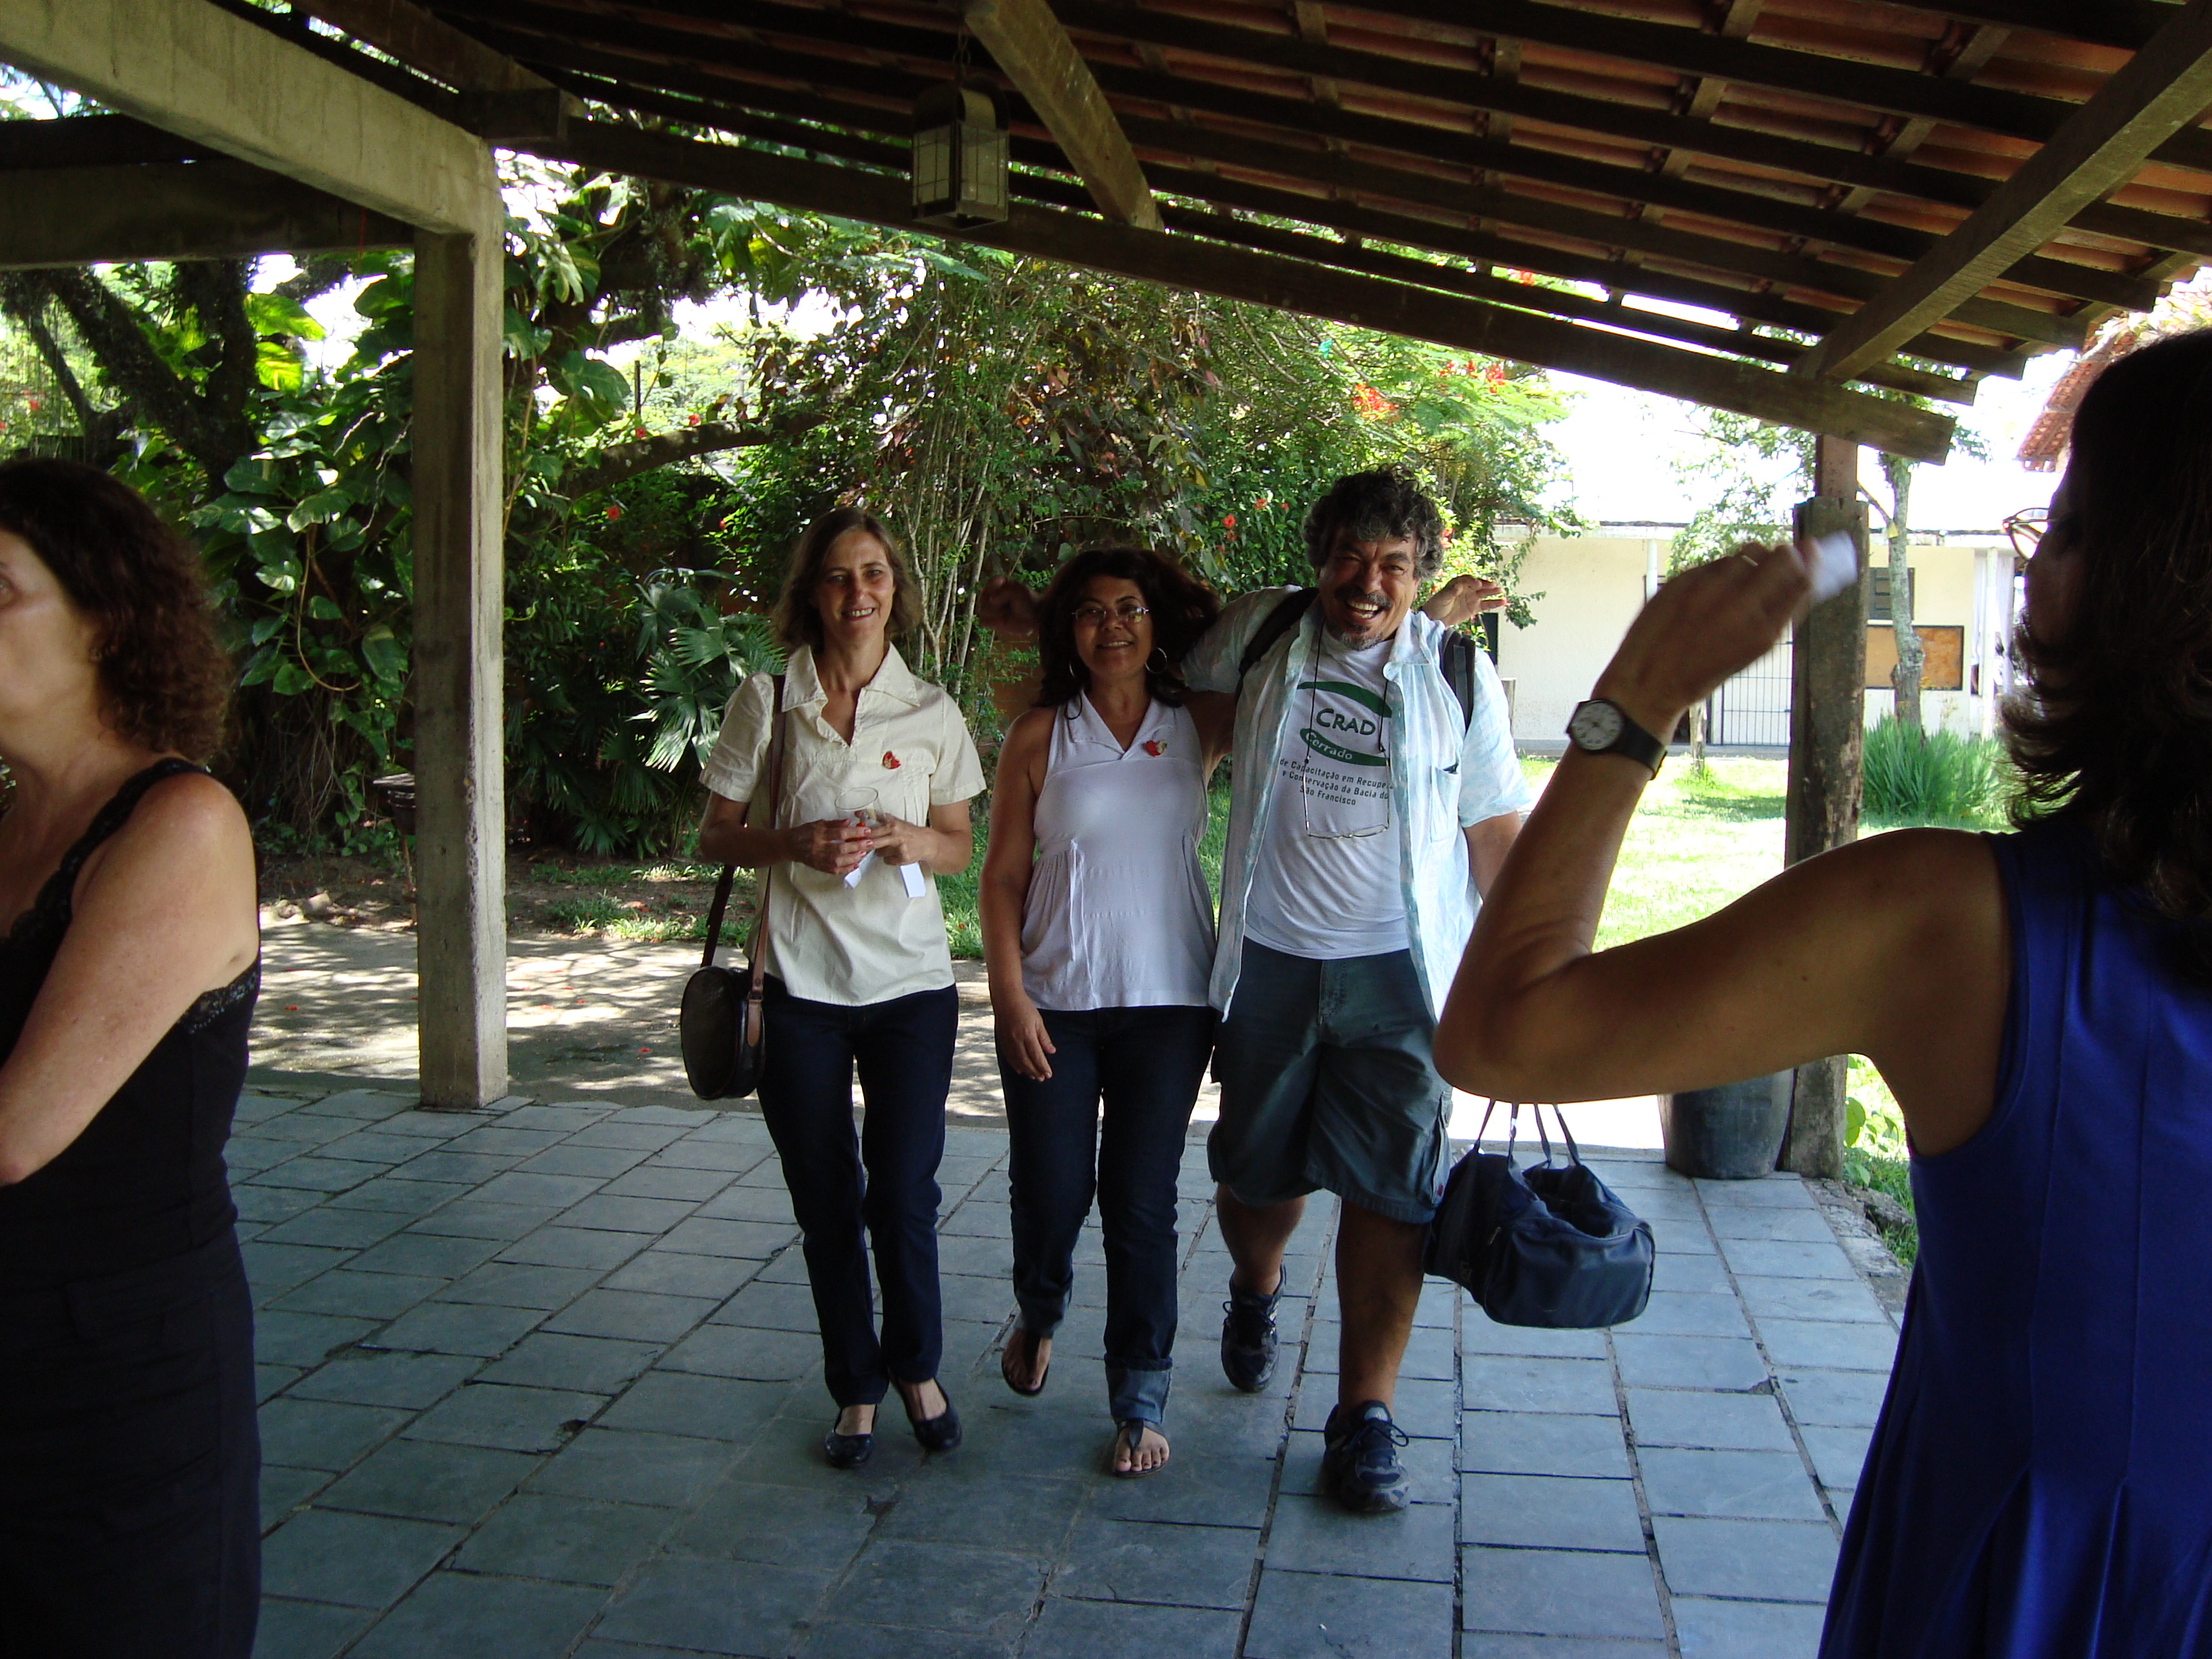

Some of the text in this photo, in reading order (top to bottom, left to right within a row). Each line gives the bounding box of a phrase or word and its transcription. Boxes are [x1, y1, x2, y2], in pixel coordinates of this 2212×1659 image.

[1316, 708, 1375, 736] CRAD
[1305, 732, 1353, 760] Cerrado
[1357, 777, 1393, 789] Recupe
[1318, 791, 1356, 805] Francisco
[1341, 785, 1351, 793] da
[1354, 787, 1377, 799] Bacia
